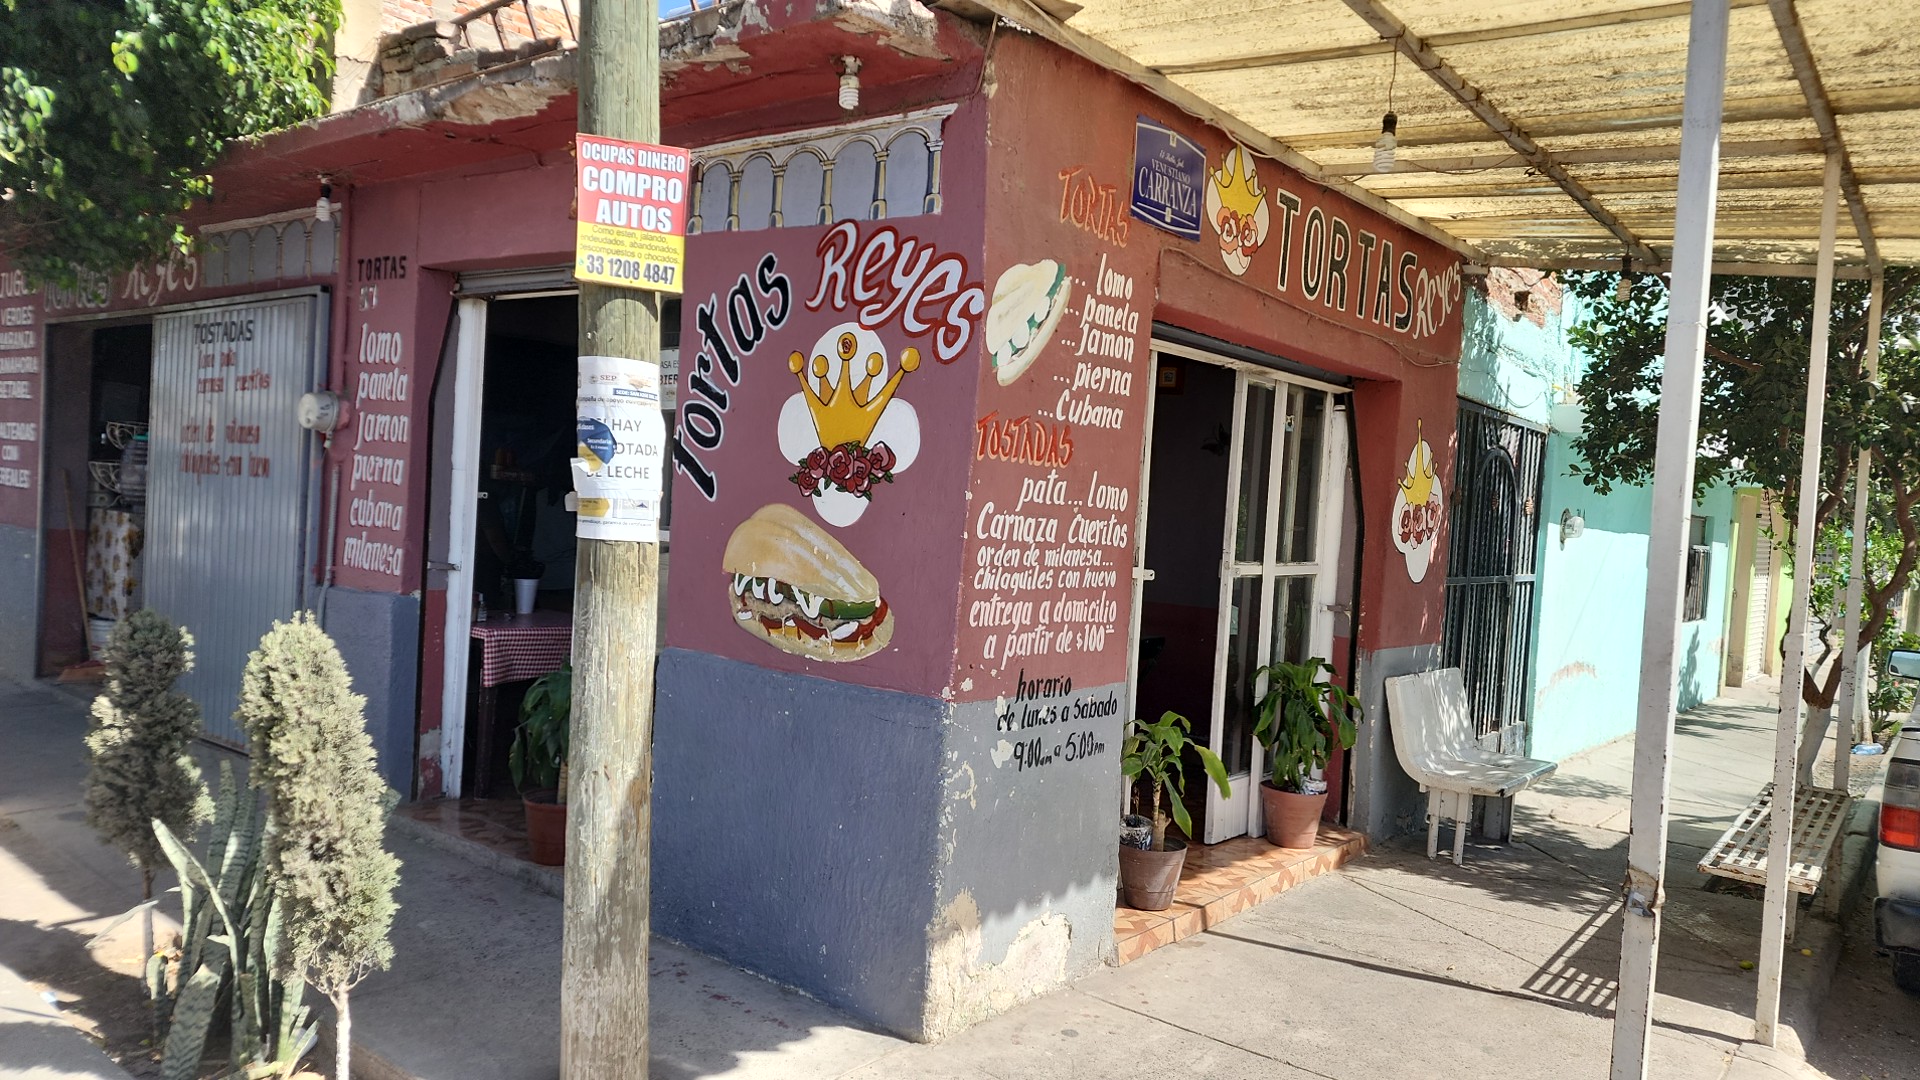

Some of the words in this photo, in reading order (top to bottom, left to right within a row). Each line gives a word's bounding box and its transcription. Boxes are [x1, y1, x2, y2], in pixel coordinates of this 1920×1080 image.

[582, 141, 635, 166] OCUPAS
[638, 149, 686, 174] DINERO
[1152, 158, 1191, 184] VENUSTIANO
[582, 165, 683, 204] COMPRO
[1138, 166, 1197, 218] CARRANZA
[595, 198, 673, 233] AUTOS
[1058, 164, 1130, 248] TORTAS
[591, 225, 615, 236] Como
[357, 256, 407, 283] TORTAS
[586, 254, 605, 275] 33
[608, 257, 641, 281] 1208
[643, 262, 676, 286] 4847
[1277, 188, 1417, 333] TORTAS
[805, 219, 985, 364] Reyes
[193, 319, 255, 344] TOSTADAS
[359, 323, 402, 364] lomo
[355, 367, 408, 409] panela
[611, 418, 642, 432] HAY
[976, 410, 1074, 468] TOSTADAS
[613, 442, 658, 457] OTADA
[351, 453, 404, 491] pierna
[607, 465, 650, 480] LECHE
[1087, 470, 1129, 512] lomo
[350, 489, 403, 531] cubana
[976, 501, 1059, 544] Carnaza
[343, 531, 403, 576] milanesa
[1023, 543, 1041, 567] de
[1057, 569, 1082, 588] con
[1082, 567, 1118, 588] huevo
[969, 592, 1033, 634] entrega
[1039, 600, 1051, 625] a
[1053, 590, 1118, 624] domicilio
[983, 634, 998, 660] a
[1000, 624, 1055, 671] partir
[1055, 624, 1074, 655] de
[1014, 667, 1073, 705] horario
[1060, 704, 1071, 723] a
[1053, 744, 1062, 757] a
